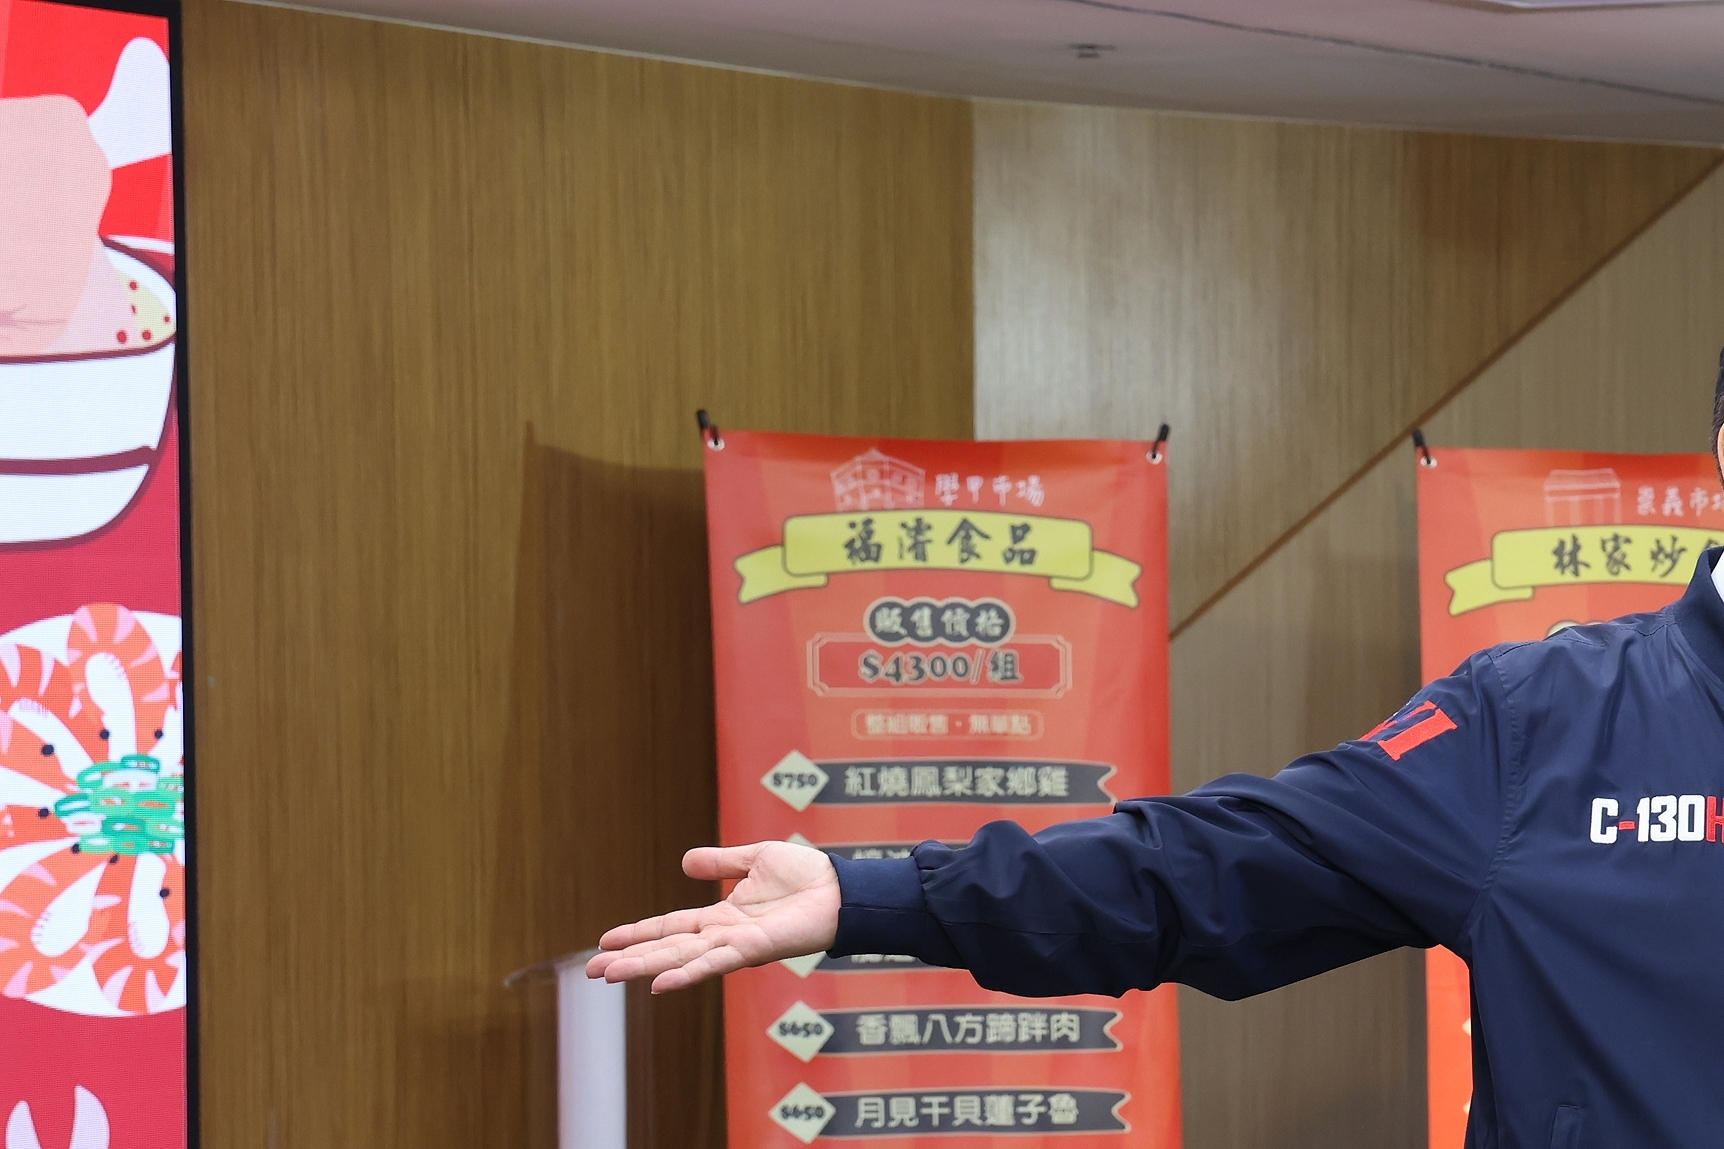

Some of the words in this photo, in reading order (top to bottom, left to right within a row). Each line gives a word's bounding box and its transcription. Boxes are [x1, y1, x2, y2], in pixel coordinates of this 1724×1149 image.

[935, 474, 1045, 507] 學甲市場
[858, 649, 1021, 685] $4300/組
[845, 766, 1068, 798] 紅燒鳳梨家鄉雞
